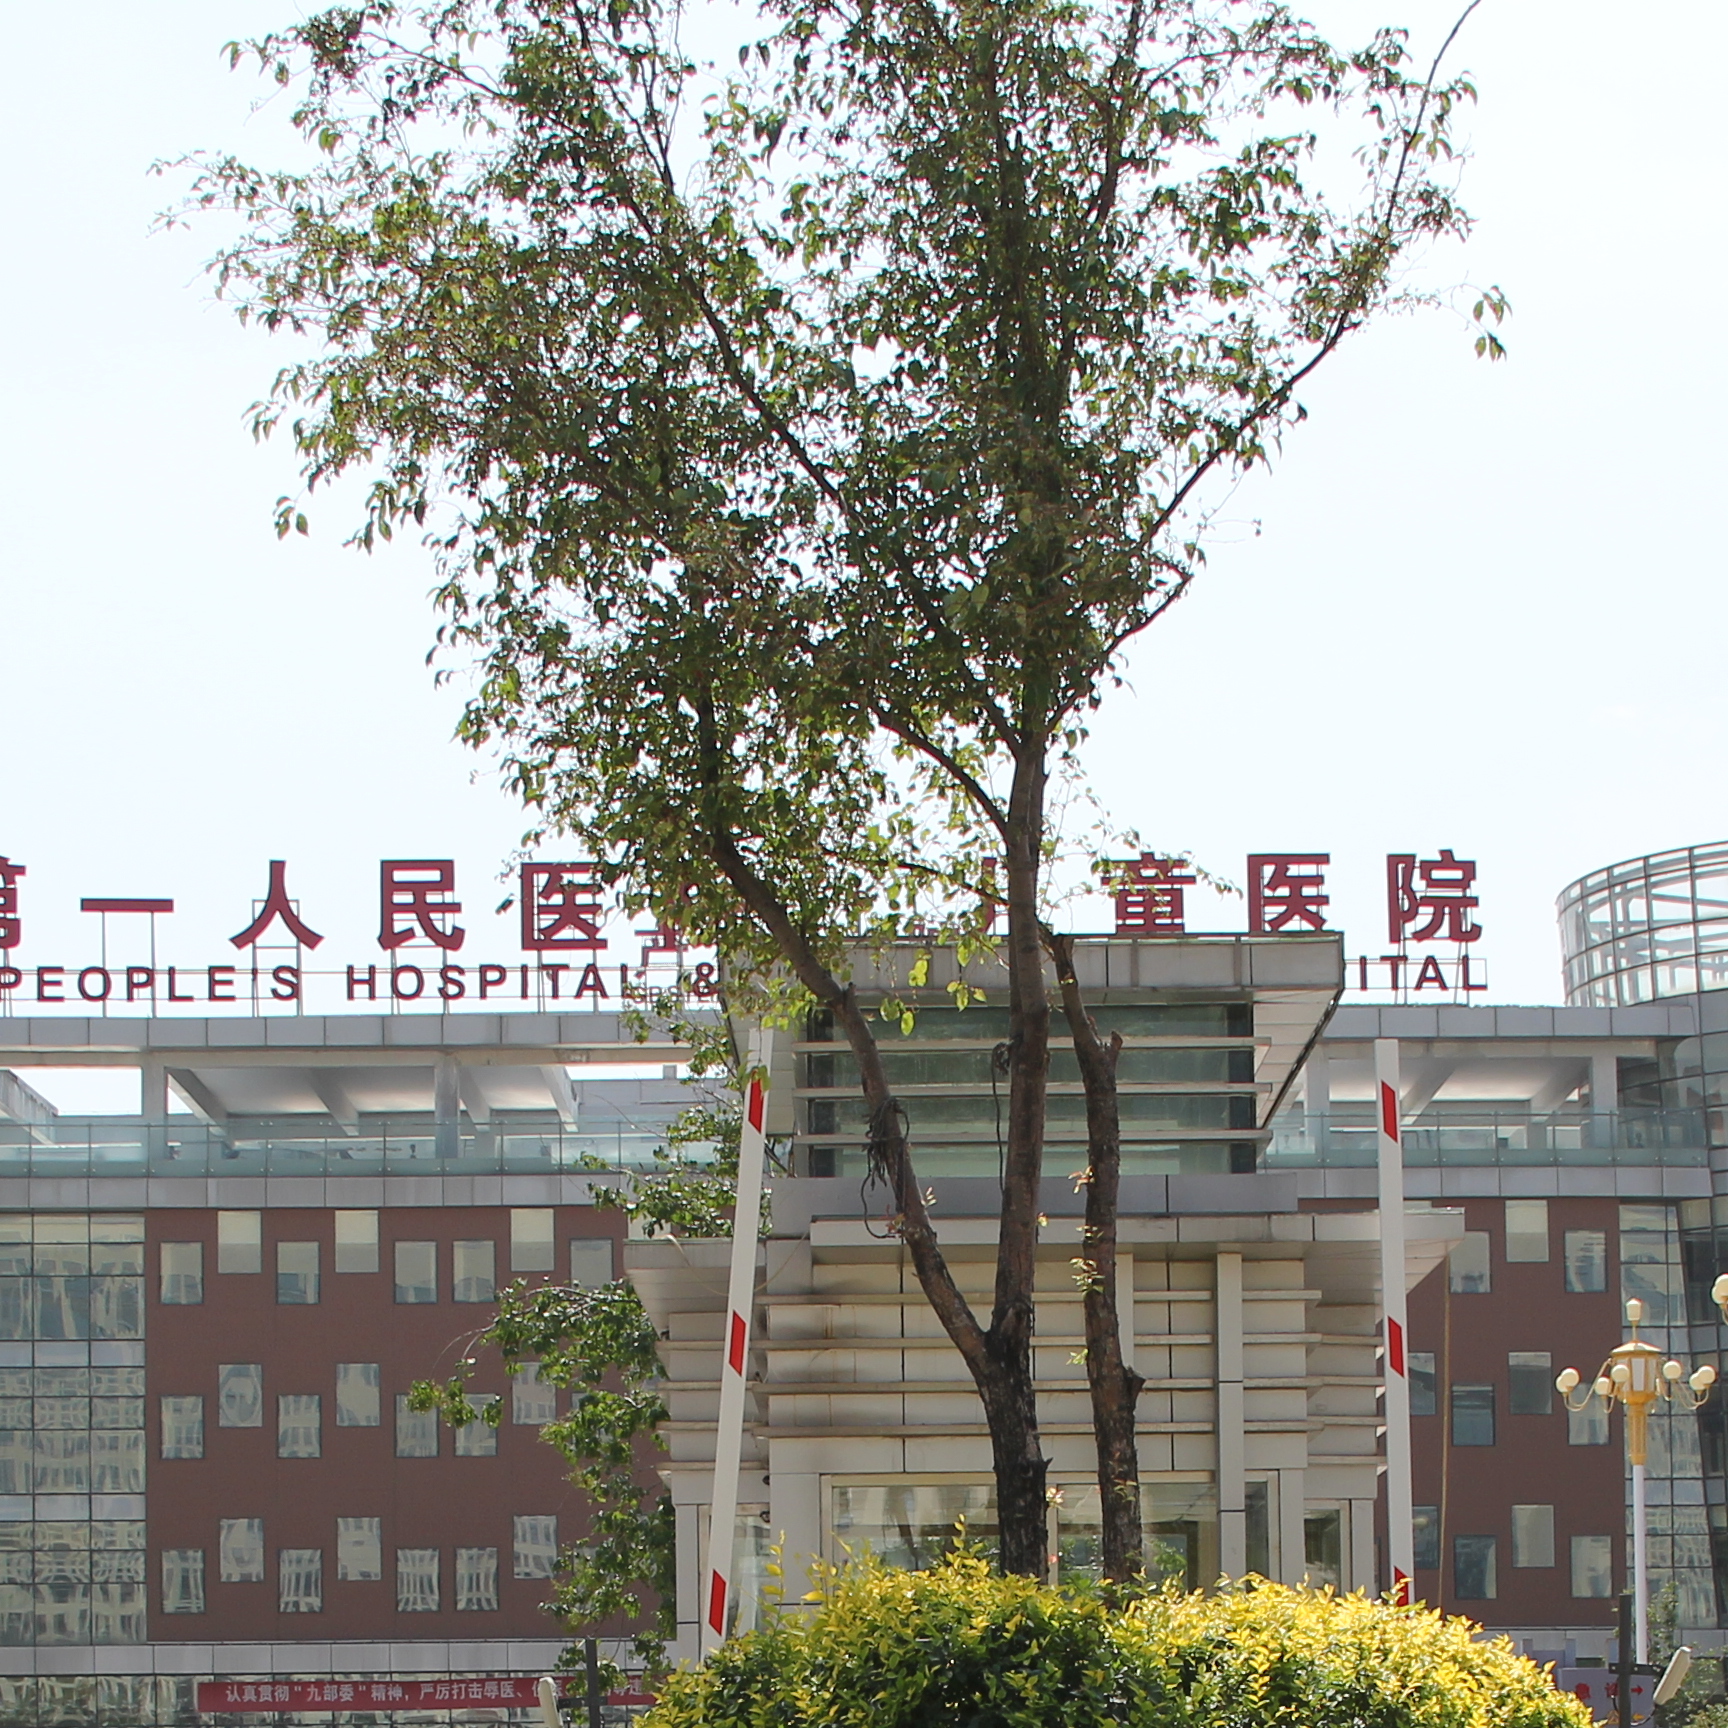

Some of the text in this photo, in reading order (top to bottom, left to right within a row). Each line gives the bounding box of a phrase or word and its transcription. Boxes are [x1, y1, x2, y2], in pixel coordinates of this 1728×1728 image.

[977, 849, 1482, 943] 童医院
[1359, 954, 1488, 992] ITAL
